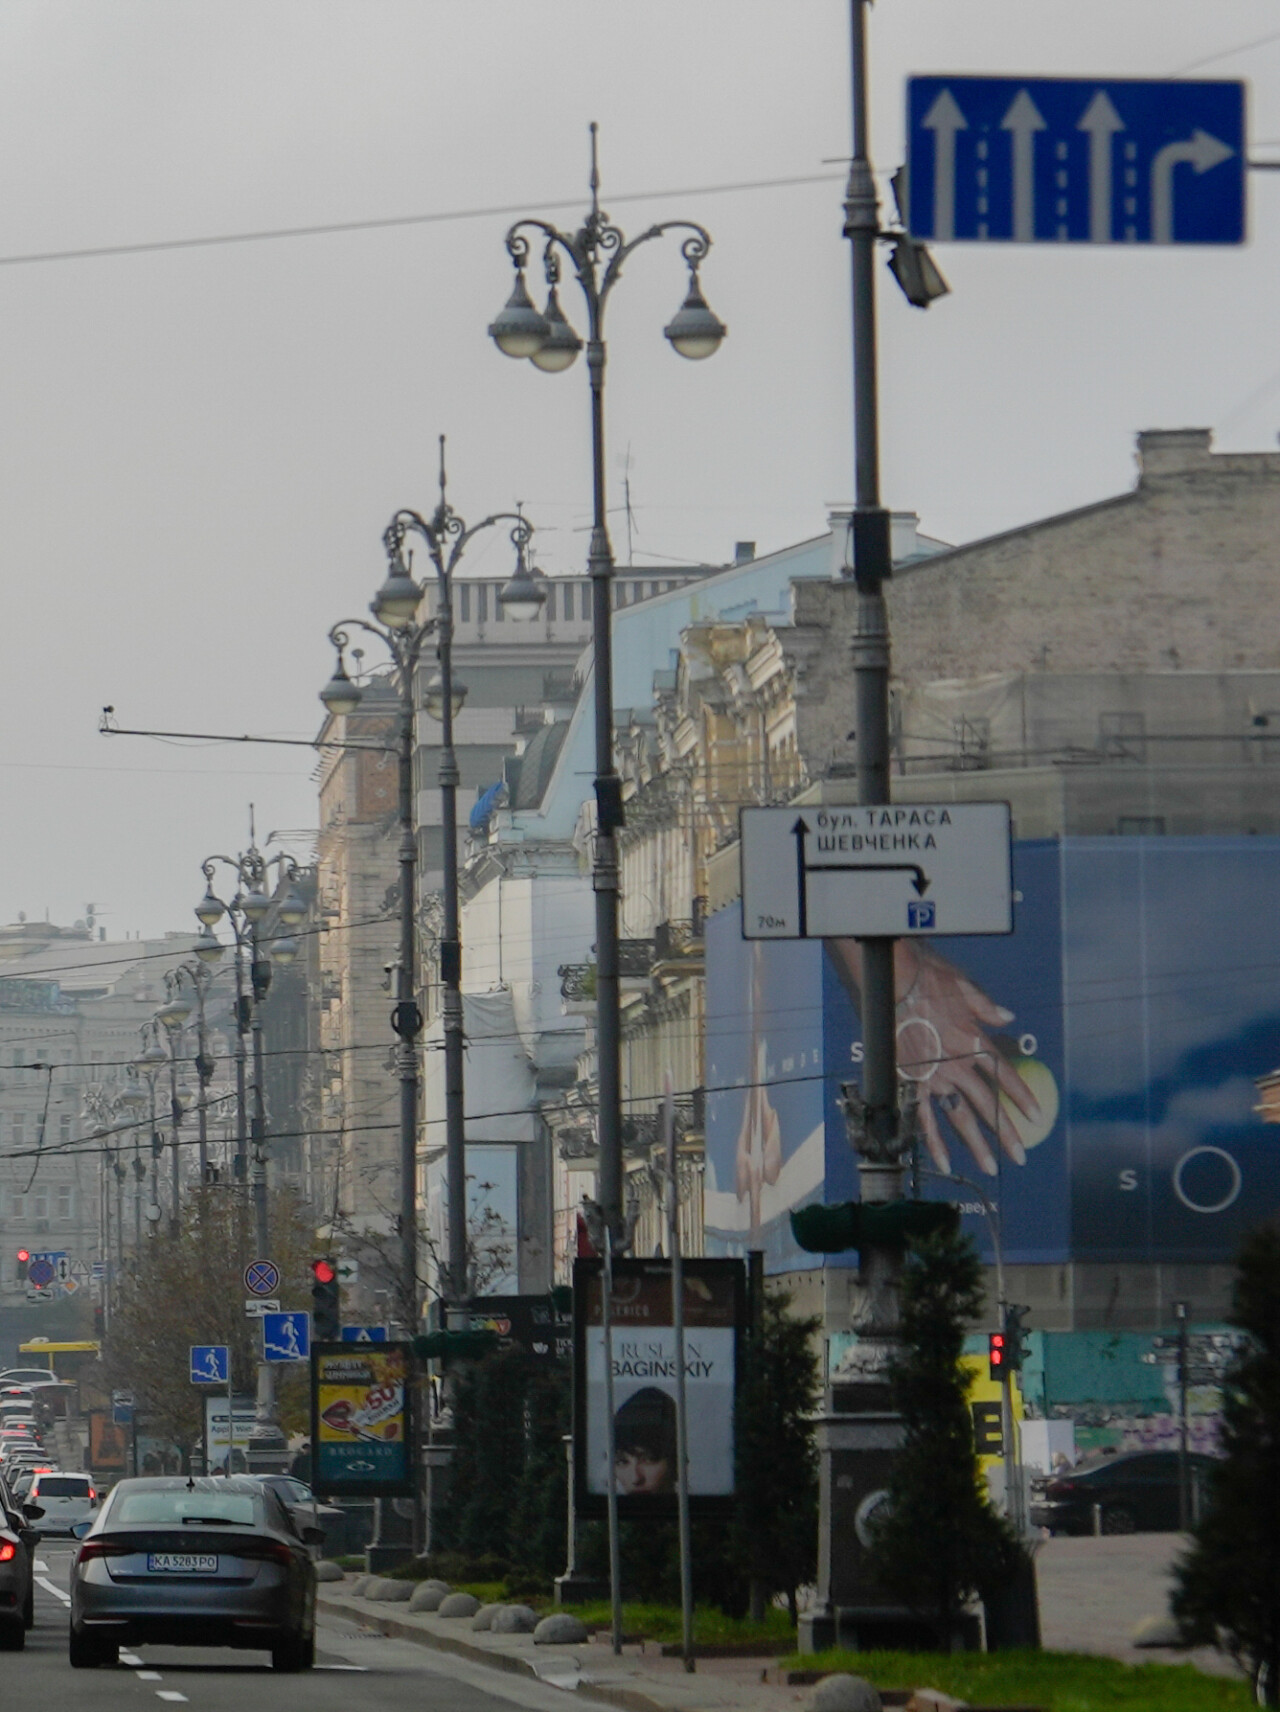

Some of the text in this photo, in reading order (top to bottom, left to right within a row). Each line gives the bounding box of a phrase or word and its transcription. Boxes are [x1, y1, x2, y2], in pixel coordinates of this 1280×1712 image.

[816, 809, 952, 829] бул. ТАРАСА
[816, 833, 937, 851] ШЕВЧЕНКА
[621, 1343, 702, 1359] RUSLN
